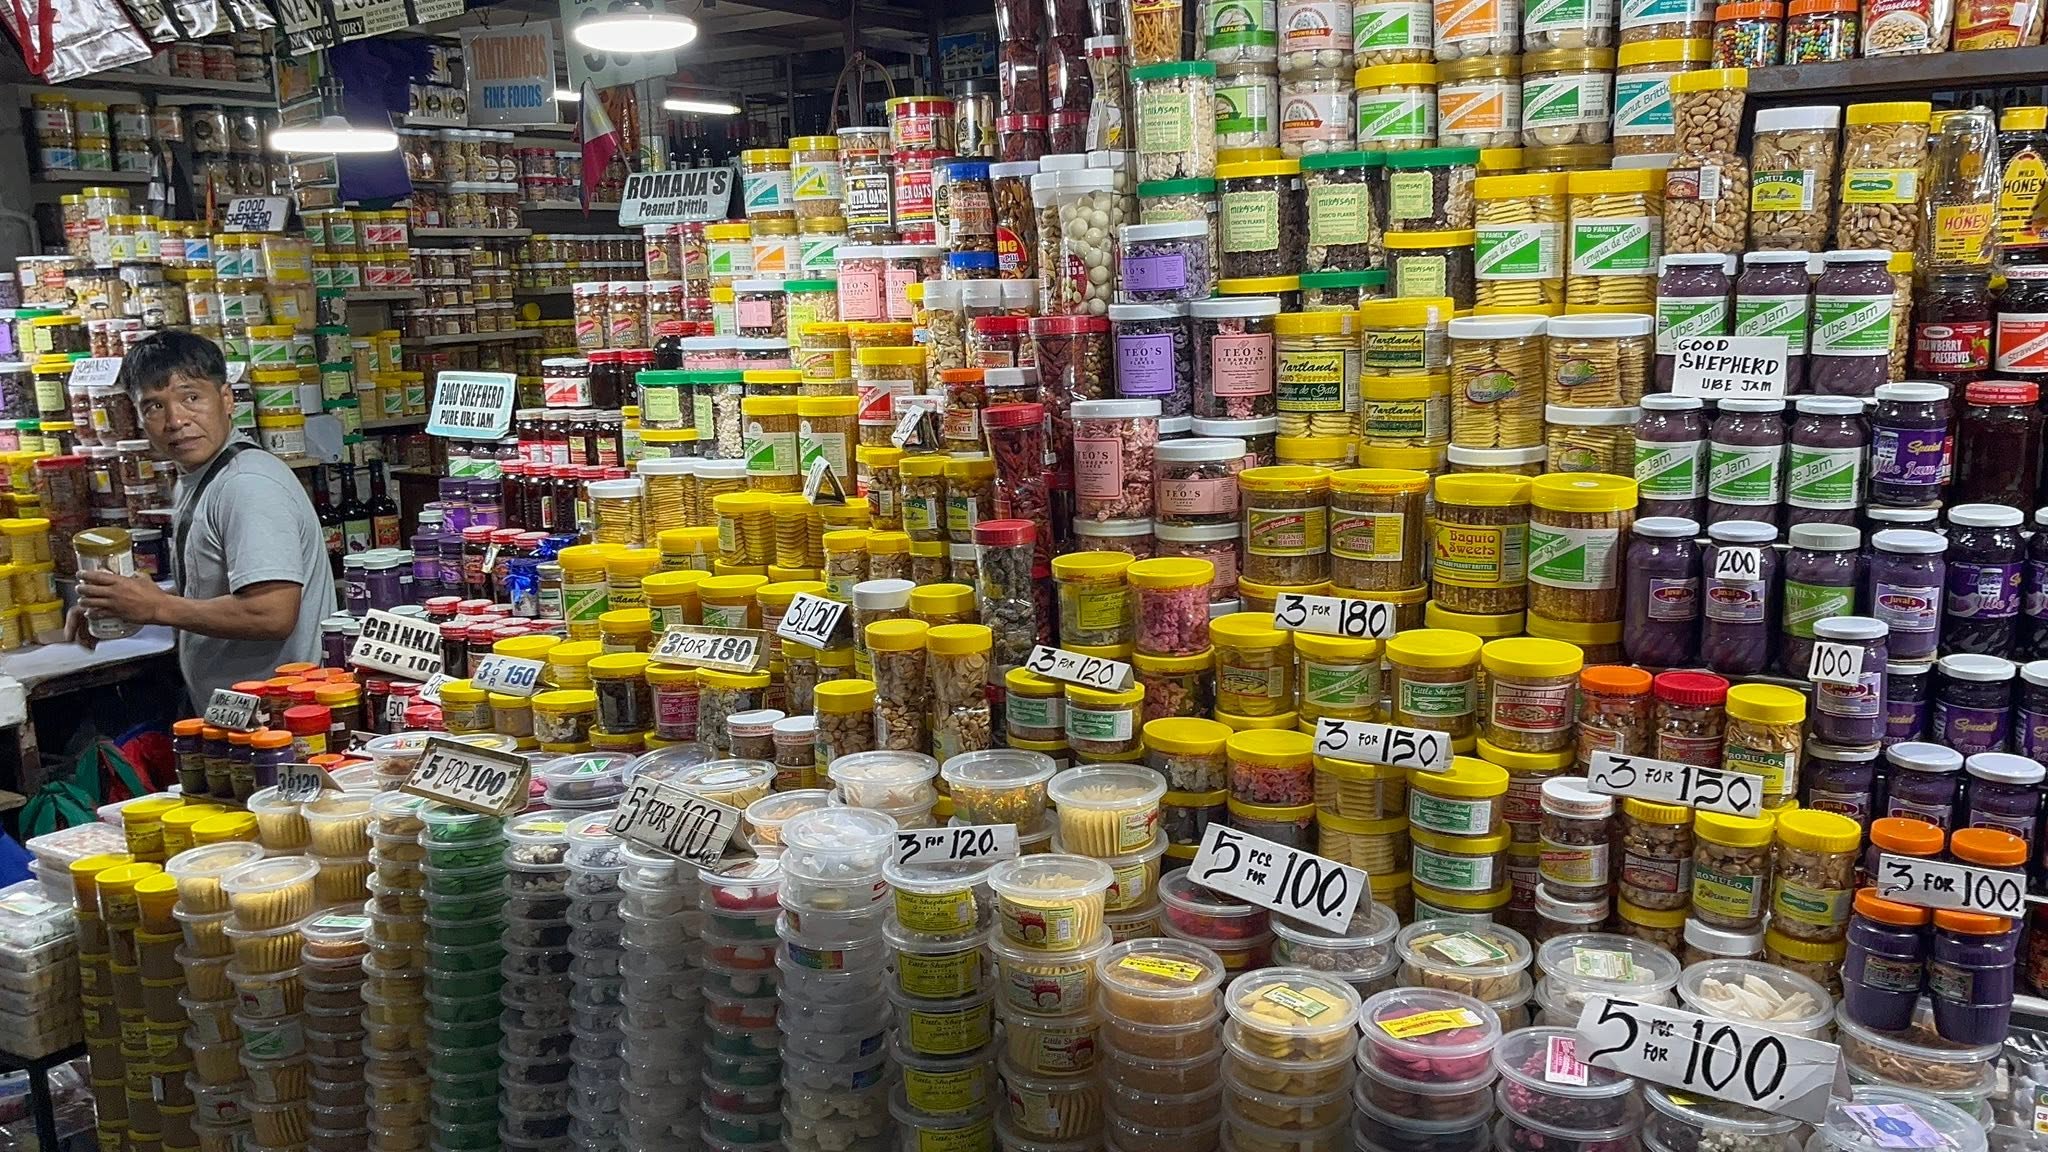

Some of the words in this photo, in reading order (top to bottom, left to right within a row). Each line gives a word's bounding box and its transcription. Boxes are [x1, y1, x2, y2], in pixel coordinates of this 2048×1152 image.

[1358, 18, 1383, 42] Lengua
[484, 87, 506, 109] FINE
[508, 85, 543, 108] FOODS
[1371, 107, 1401, 132] Lengua
[1616, 98, 1642, 123] Peanut
[1753, 175, 1803, 187] ROMULO'S
[2018, 168, 2035, 178] WILD
[627, 170, 729, 200] ROMANA'S
[913, 183, 932, 199] OATS
[2002, 178, 2047, 194] HONEY
[237, 199, 266, 213] GOOD
[869, 189, 888, 204] OATS
[638, 199, 675, 217] Peanut
[677, 197, 708, 216] Brittle
[1958, 206, 1978, 215] WILD
[225, 211, 272, 226] SHEPHERD
[1944, 214, 1989, 231] HONEY
[1593, 225, 1622, 233] FAMILY
[1499, 243, 1509, 254] de
[1509, 232, 1529, 249] Gato
[1582, 244, 1611, 268] Lengua
[1611, 237, 1622, 249] de
[1622, 224, 1642, 244] Gato
[1670, 320, 1694, 340] Ube
[1697, 305, 1721, 326] Jam
[1738, 319, 1758, 336] Ube
[1761, 305, 1789, 326] Jam
[1822, 318, 1848, 339] Ube
[1850, 304, 1878, 326] Jam
[1371, 333, 1417, 345] Tartland
[1677, 339, 1729, 352] GOOD
[1124, 346, 1162, 357] TEO'S
[1223, 346, 1264, 357] TEO'S
[1930, 350, 1970, 364] PRESERVES
[1282, 360, 1334, 373] Tartland
[1678, 352, 1779, 376] SHEPHERD
[438, 381, 459, 406] GOOD
[1701, 377, 1732, 392] UBE
[1741, 378, 1772, 392] JAM
[439, 409, 459, 426] PURE
[460, 410, 475, 426] UBE
[476, 411, 494, 428] JAM
[1372, 404, 1418, 415] Tartland
[1907, 439, 1943, 454] Special
[1650, 451, 1673, 472] Jam
[1725, 456, 1751, 476] Jam
[1804, 457, 1832, 479] Jam
[1903, 457, 1936, 479] Jam
[1165, 490, 1201, 498] TEO'S
[1450, 529, 1495, 546] Baguio
[1448, 542, 1496, 556] Sweets
[786, 596, 804, 624] 3
[804, 600, 840, 638] 150
[1274, 595, 1308, 629] 3
[1310, 604, 1331, 617] FOR
[1337, 598, 1387, 638] 180
[661, 633, 681, 655] 3
[679, 637, 704, 655] FOR
[702, 636, 753, 663] 180
[360, 643, 371, 657] 3
[373, 646, 402, 665] for
[408, 655, 440, 675] 100
[1028, 648, 1057, 673] 3
[1057, 657, 1076, 669] FOR
[478, 661, 489, 679] 3
[506, 664, 537, 687] 150
[1412, 686, 1431, 696] Little
[1432, 685, 1466, 697] Shepherd
[389, 700, 405, 717] 50
[1318, 720, 1351, 751] 3
[1358, 731, 1378, 747] FOR
[1954, 718, 1998, 733] Special
[1727, 752, 1785, 768] ROMULO'S
[420, 754, 441, 781] 5
[443, 758, 469, 792] FOR
[462, 763, 508, 797] 100
[1595, 755, 1637, 789] 3
[1644, 767, 1674, 783] FOR
[613, 786, 647, 834] 5
[642, 804, 675, 834] FOR
[662, 800, 723, 860] 100
[898, 832, 922, 865] 3
[925, 834, 944, 849] FOR
[1203, 830, 1244, 880] 5
[1246, 868, 1267, 887] FOR
[1696, 870, 1752, 893] ROMULO'S
[1884, 863, 1915, 897] 3
[1923, 875, 1955, 894] FOR
[918, 895, 958, 905] Shepherd
[929, 956, 968, 970] Shepherd
[1588, 998, 1641, 1064] 5
[1643, 1042, 1669, 1063] FOR
